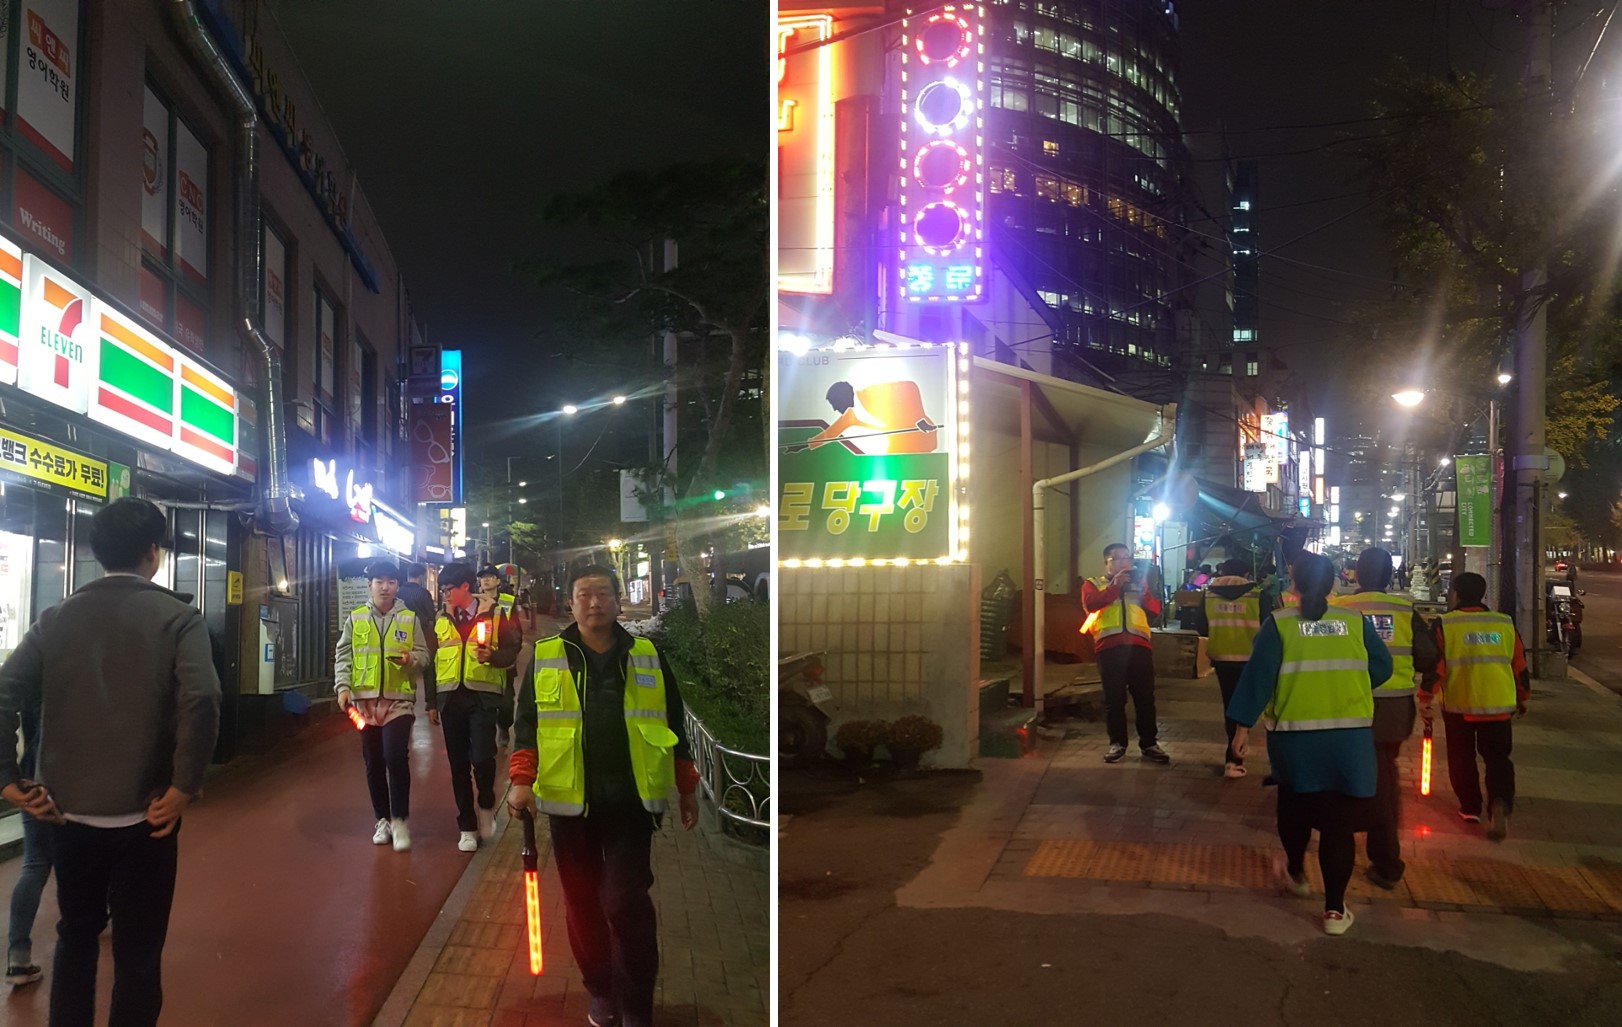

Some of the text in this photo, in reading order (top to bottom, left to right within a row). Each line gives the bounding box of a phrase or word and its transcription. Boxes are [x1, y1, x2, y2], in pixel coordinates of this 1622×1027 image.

[27, 47, 69, 103] 영어학원
[20, 207, 66, 255] Writing
[798, 355, 830, 366] CLUB
[0, 438, 27, 465] 뱅크
[30, 447, 77, 480] 수수료가
[80, 464, 104, 489] 무료!
